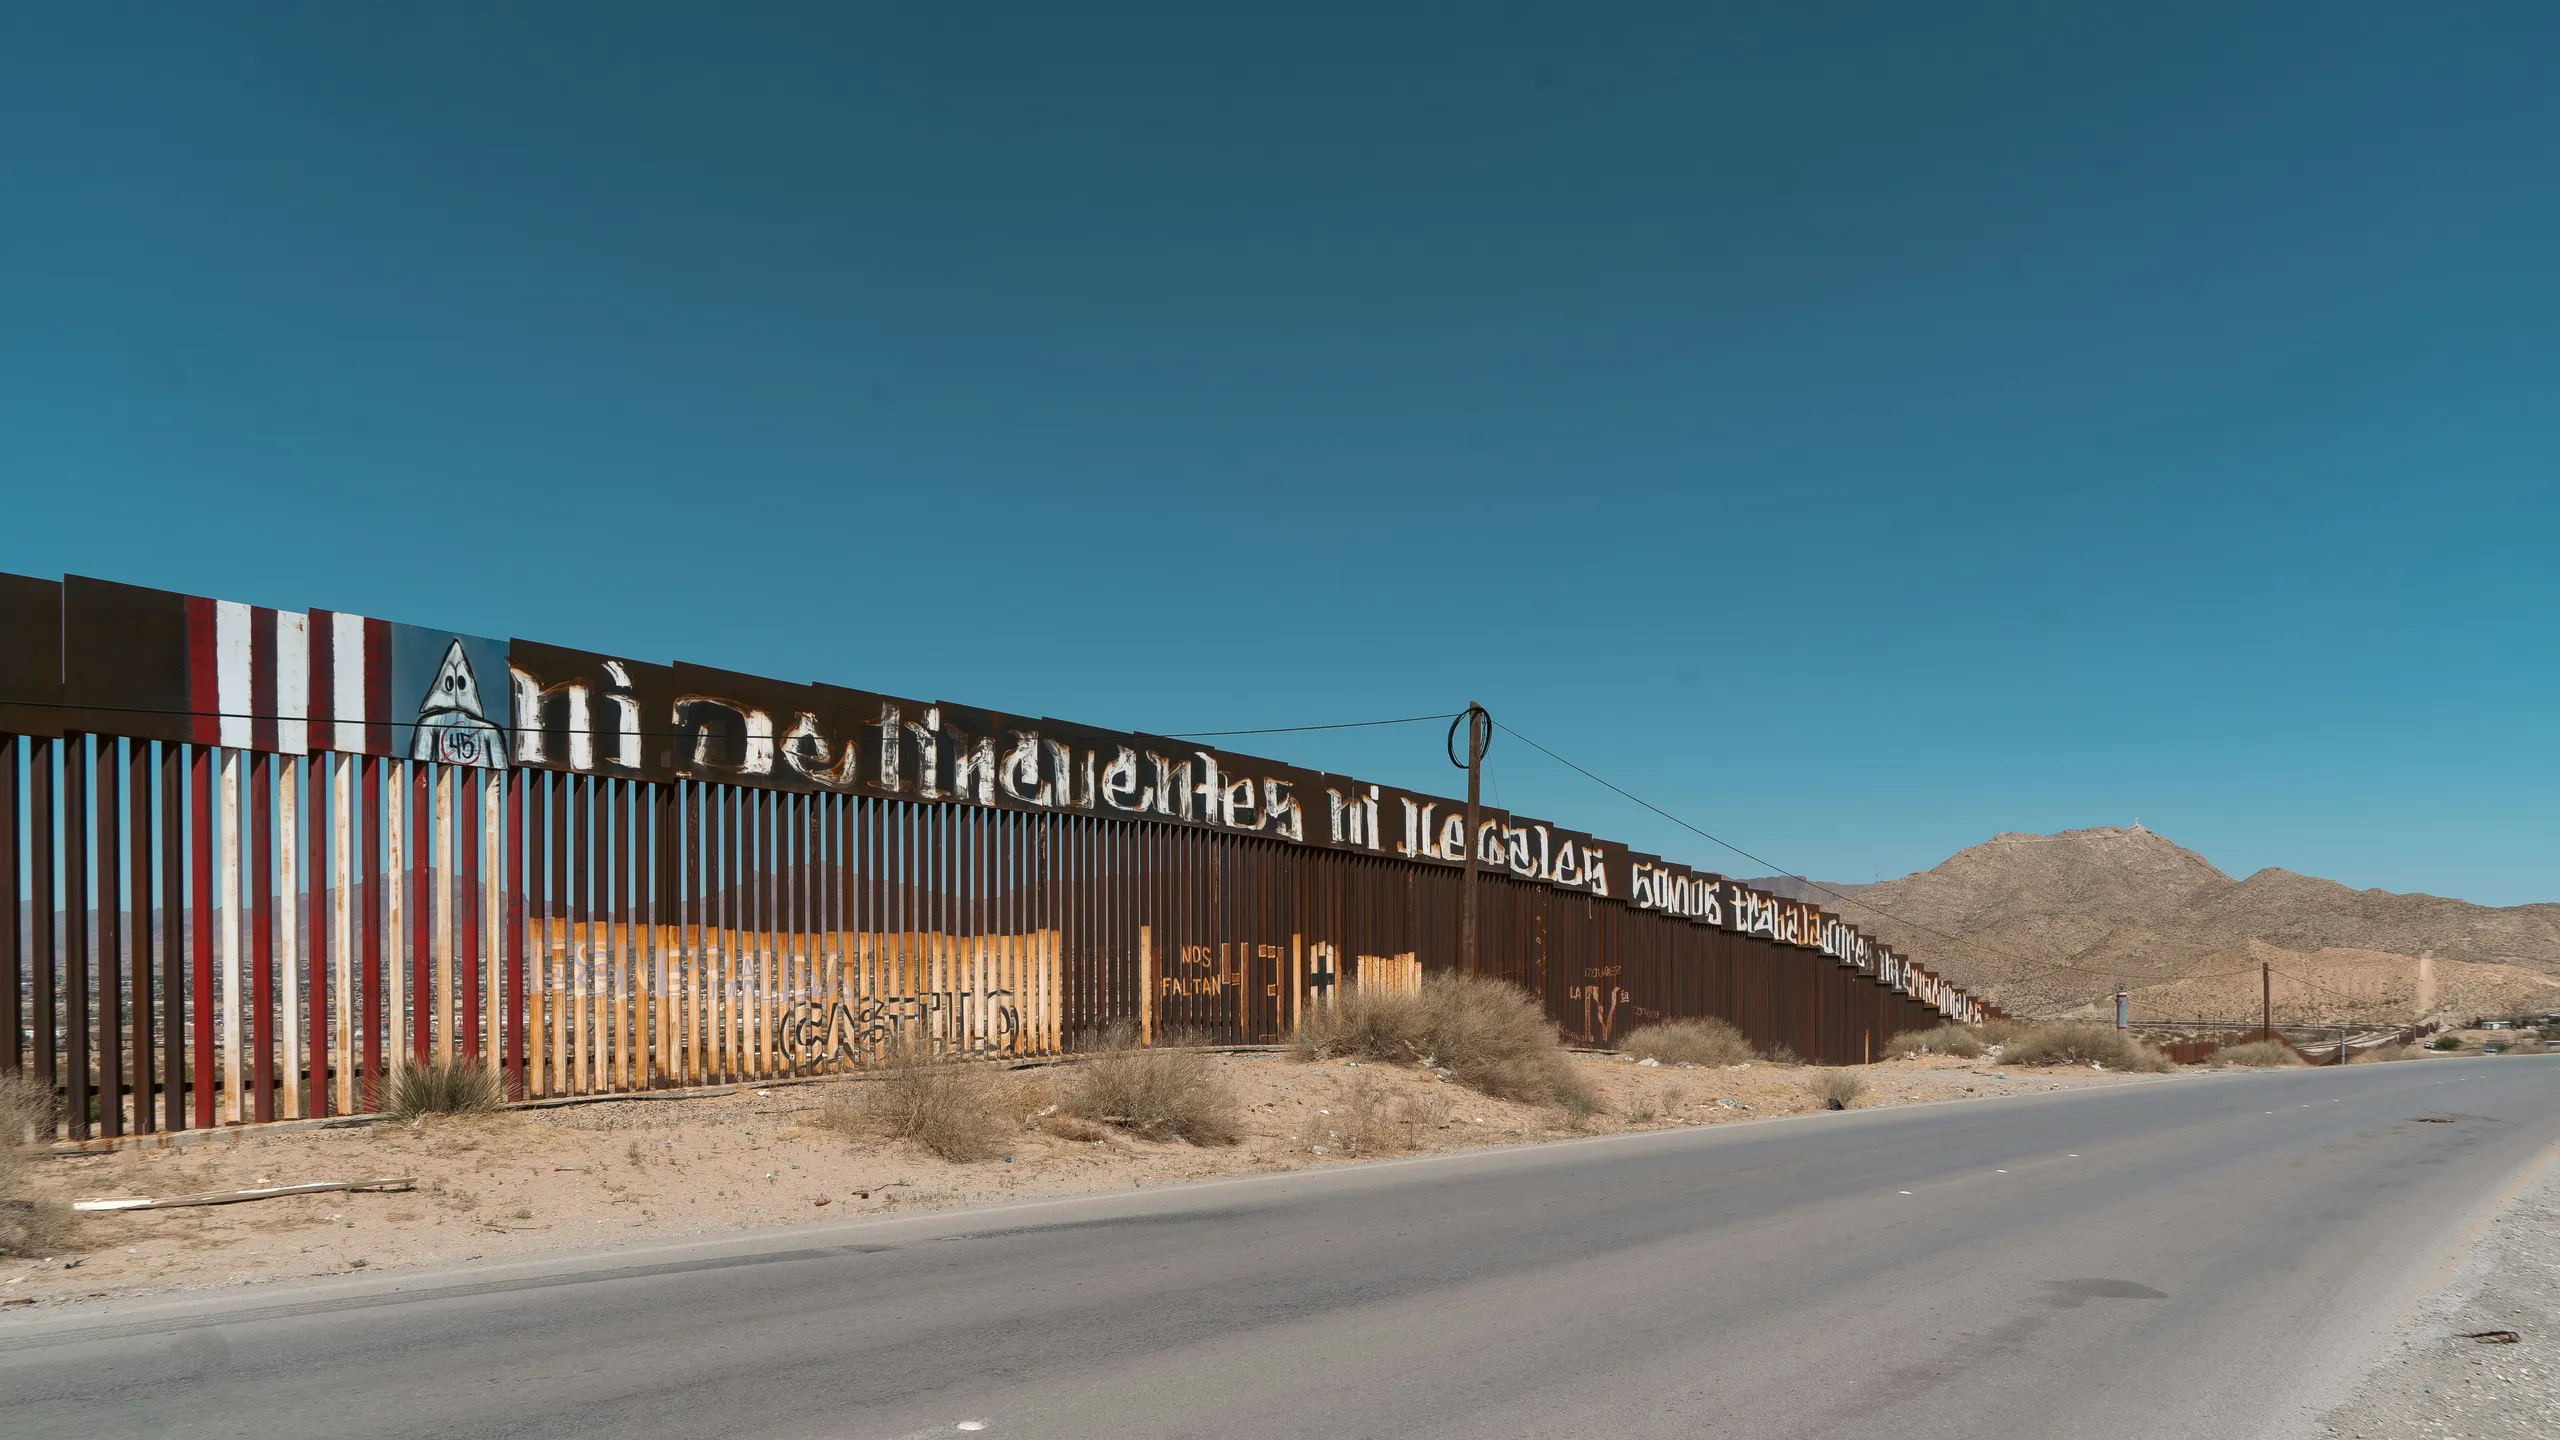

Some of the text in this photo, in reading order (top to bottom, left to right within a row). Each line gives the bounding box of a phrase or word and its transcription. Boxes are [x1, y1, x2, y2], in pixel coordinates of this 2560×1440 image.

[449, 732, 475, 759] 45
[1181, 945, 1212, 968] NOS
[1162, 974, 1222, 997] FALTAN
